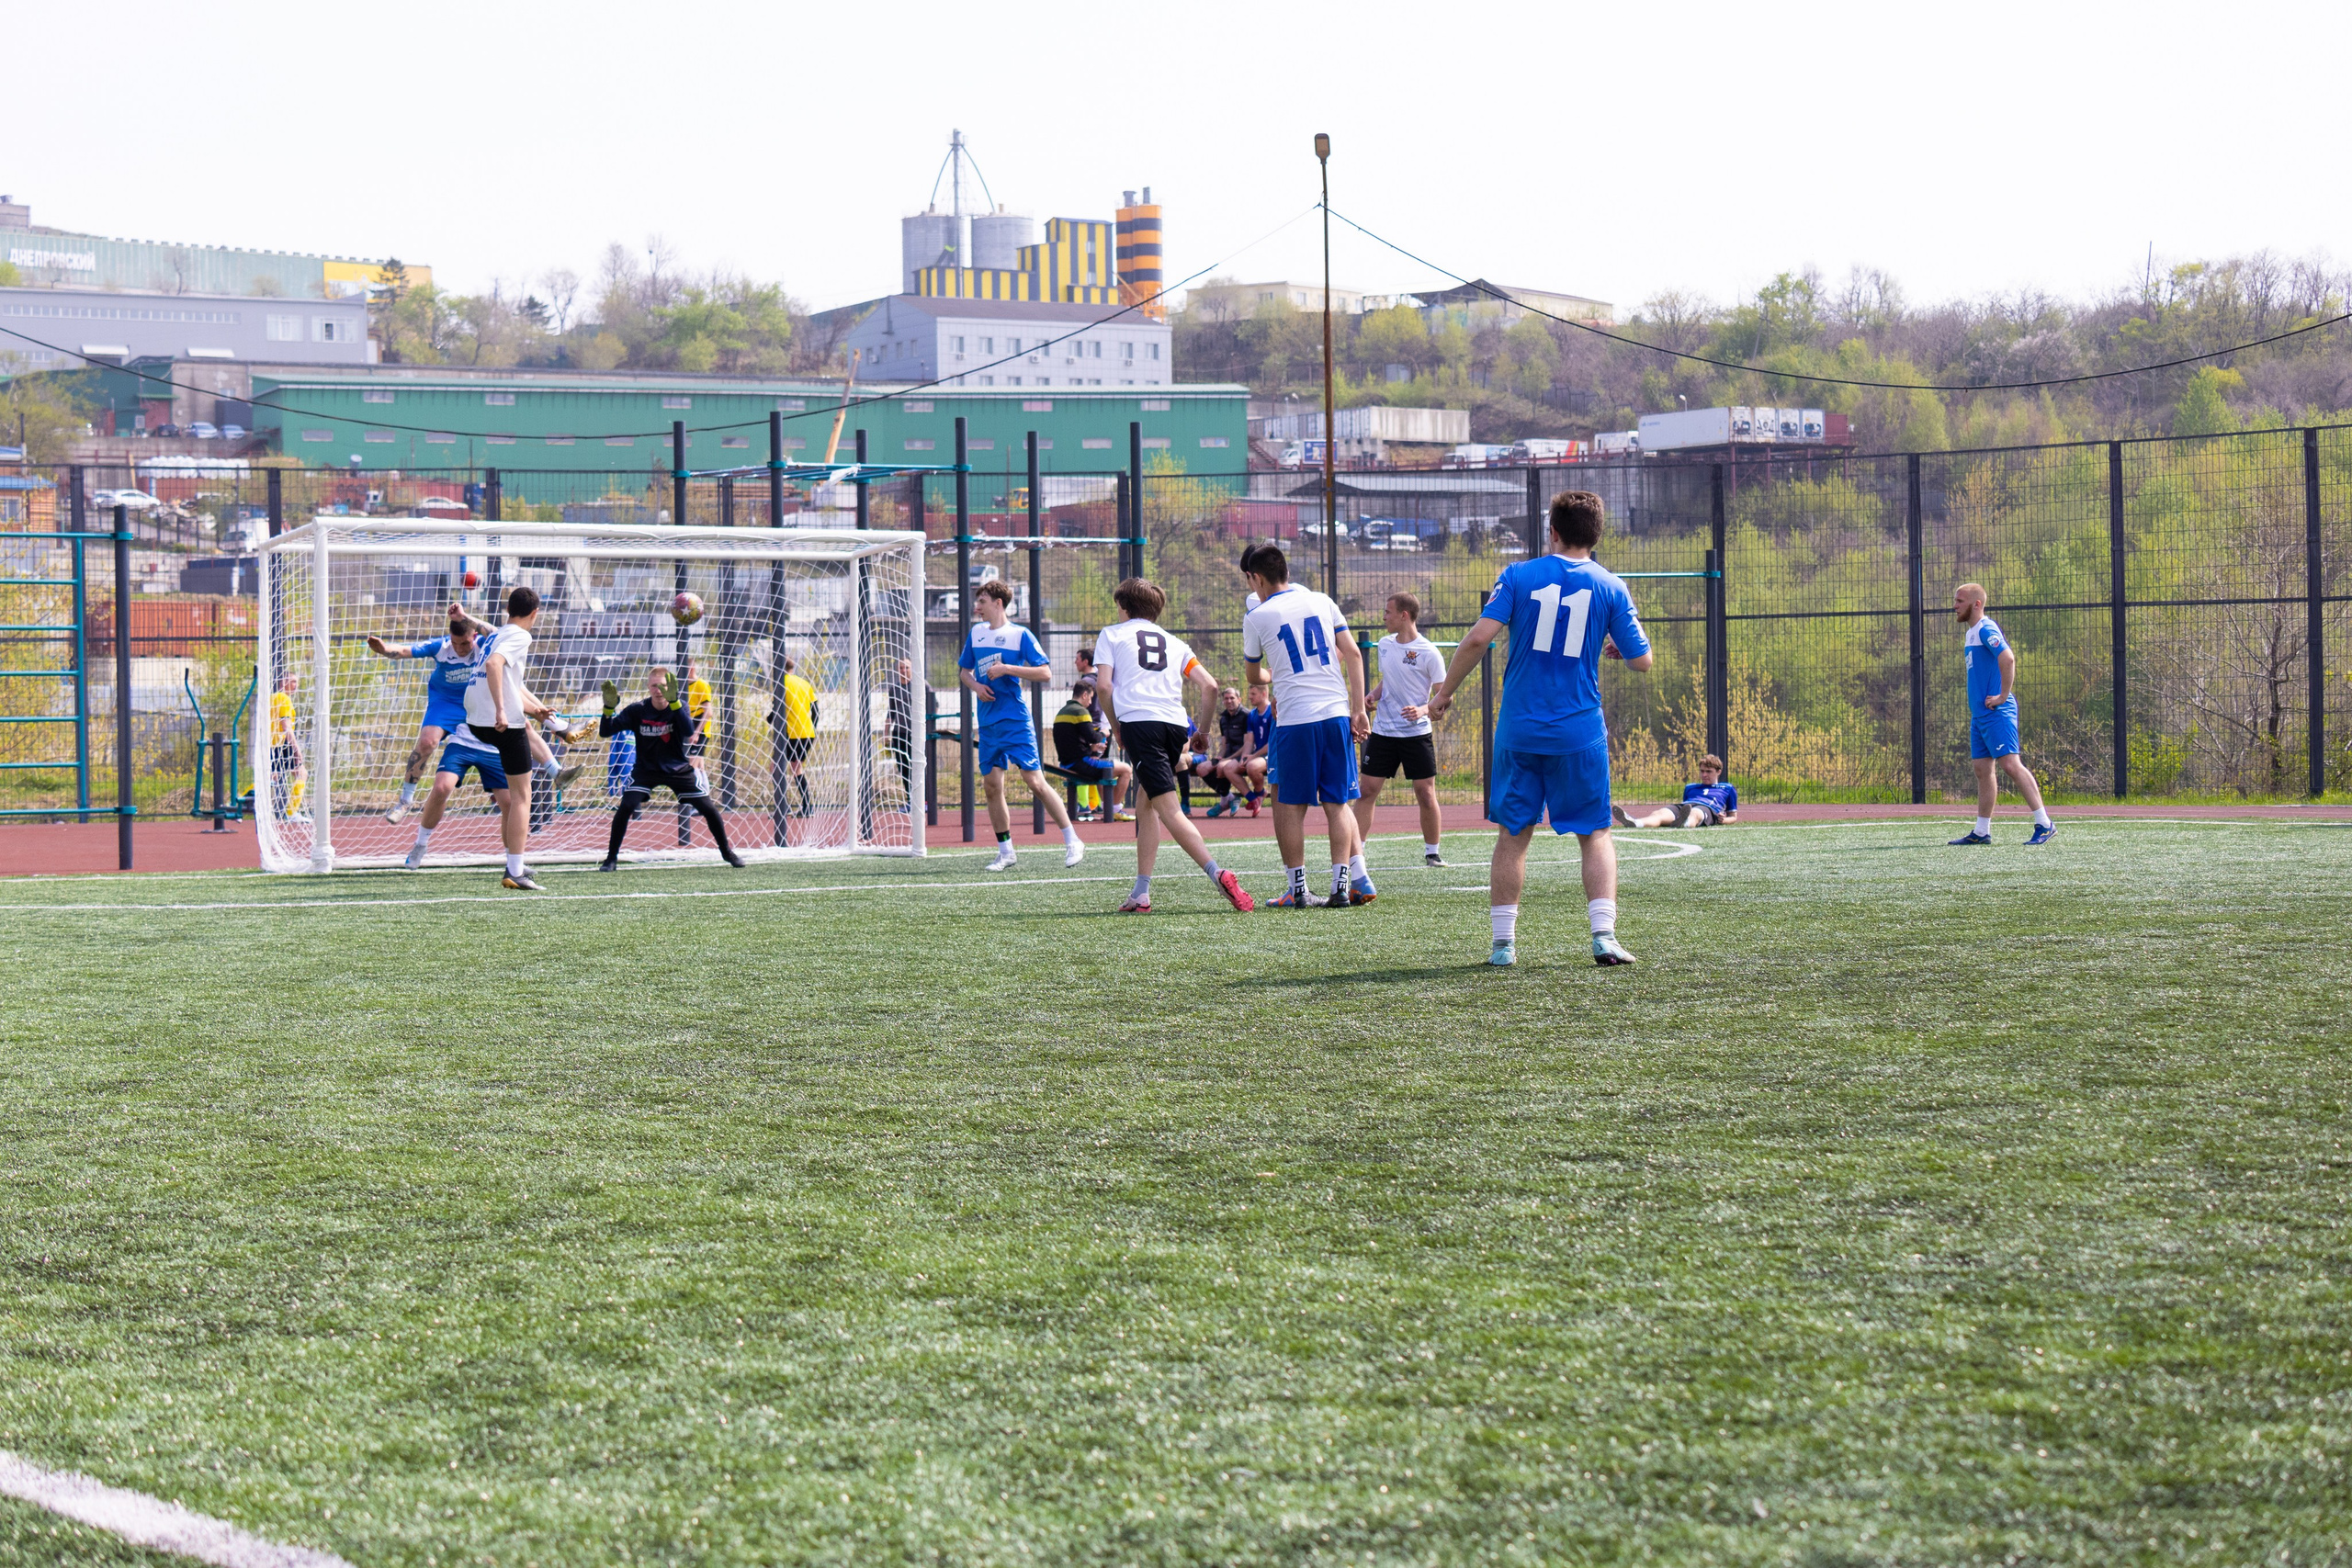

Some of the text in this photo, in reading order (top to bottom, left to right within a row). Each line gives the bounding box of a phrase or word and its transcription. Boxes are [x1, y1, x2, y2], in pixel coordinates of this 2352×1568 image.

[9, 248, 96, 271] ДНЕПРОВСКИЙ
[1276, 615, 1330, 674] 14
[1531, 583, 1592, 659] 11
[1136, 629, 1168, 672] 8
